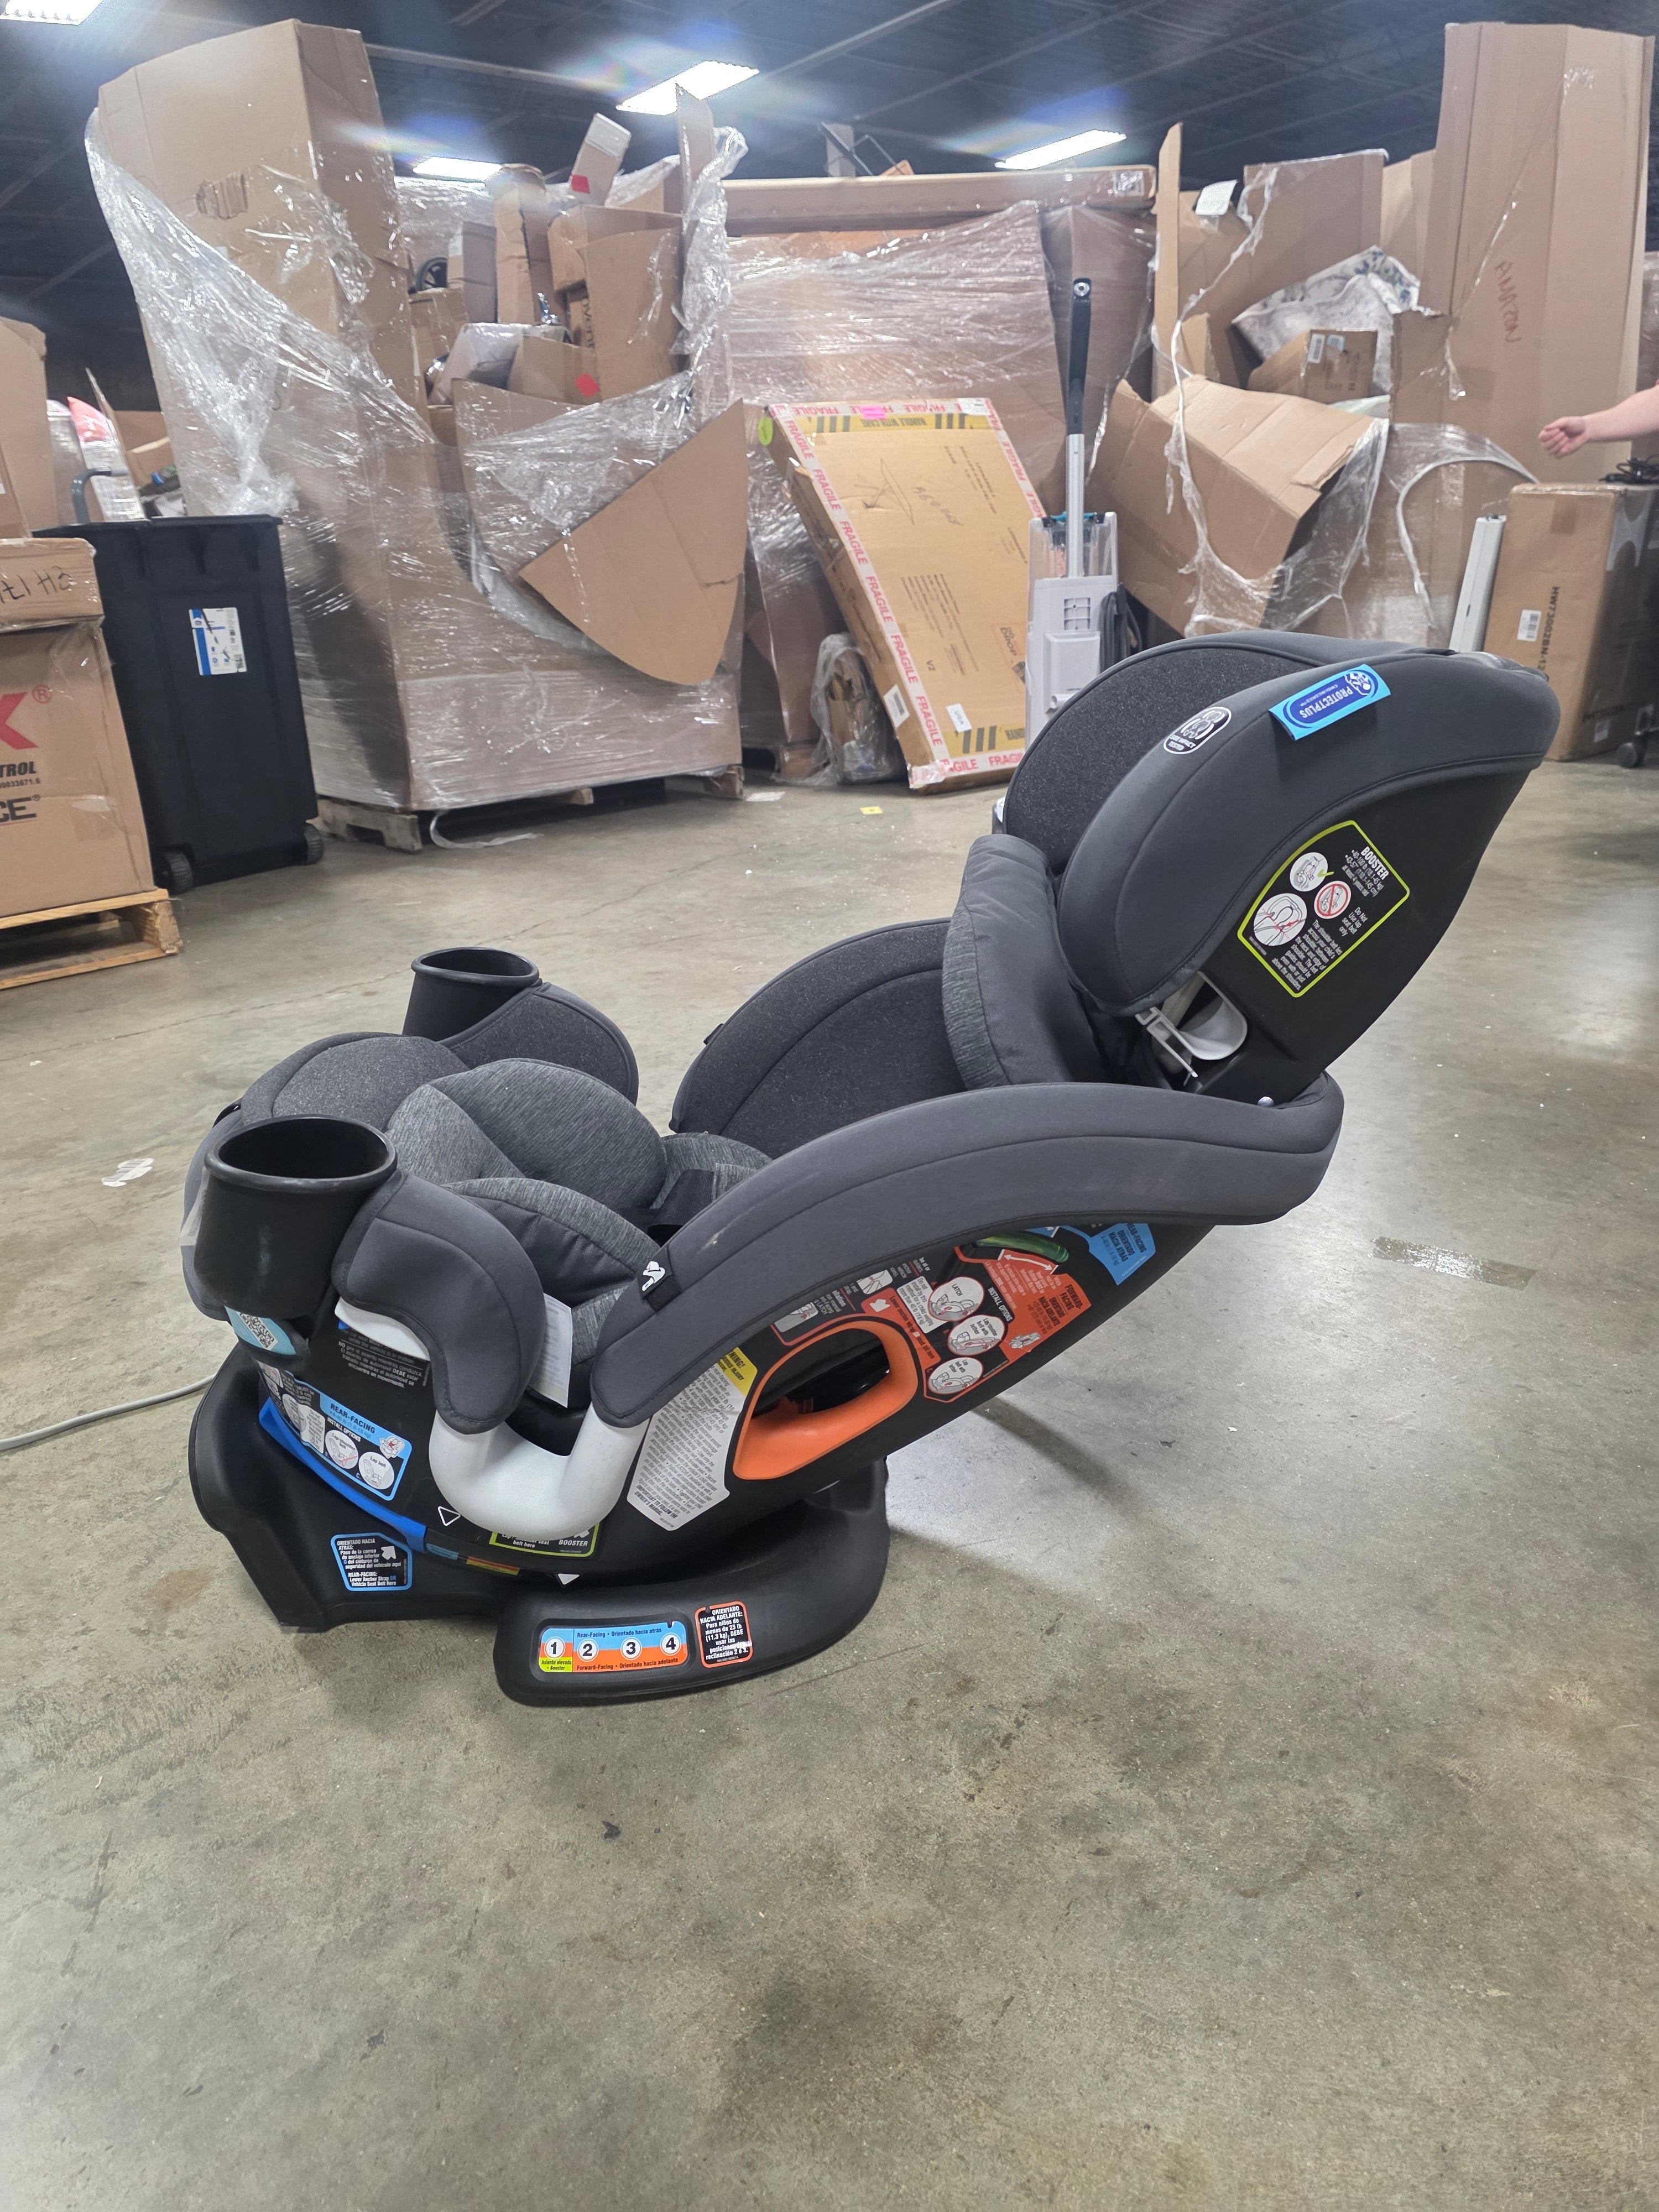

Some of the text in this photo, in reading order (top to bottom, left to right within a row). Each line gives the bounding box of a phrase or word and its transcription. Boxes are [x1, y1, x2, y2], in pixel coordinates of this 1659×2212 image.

[785, 420, 815, 460] FRAGILE
[813, 468, 842, 511] FRAGILE
[840, 520, 868, 565] FRAGILE
[865, 576, 893, 623] FRAGILE
[1000, 627, 1018, 657] DROP
[891, 634, 918, 684] FRAGILE
[925, 659, 936, 672] V2
[1298, 685, 1353, 719] PROTECTPLUS
[916, 696, 942, 746] FRAGILE
[1360, 846, 1390, 880] BOOSTER
[1348, 912, 1357, 922] Use
[1353, 906, 1368, 922] Do Not
[1108, 1230, 1120, 1248] HACIA
[1117, 1229, 1135, 1256] ORIENTADO
[951, 1283, 963, 1297] LATCH
[987, 1286, 1013, 1322] INSTALL OPTIONS
[1058, 1291, 1074, 1311] FACING
[392, 1368, 406, 1376] DEBE
[399, 1364, 423, 1377] conduzca.
[711, 1395, 721, 1406] year
[329, 1403, 376, 1434] REAR-FACING
[326, 1417, 362, 1442] INSTALL OPTIONS
[634, 1490, 650, 1505] OWNER'S
[635, 1484, 656, 1502] IMPORTANT
[658, 1503, 672, 1515] FOLLOW
[712, 1605, 739, 1615] ORIENTADO
[716, 1611, 743, 1620] ADELANTE:
[730, 1629, 743, 1637] DEBE
[550, 1642, 557, 1654] 1
[581, 1643, 593, 1657] 2
[625, 1641, 636, 1655] 3
[665, 1637, 676, 1650] 4
[706, 1650, 733, 1660] reclinación
[576, 1663, 613, 1671] Forward-Facing
